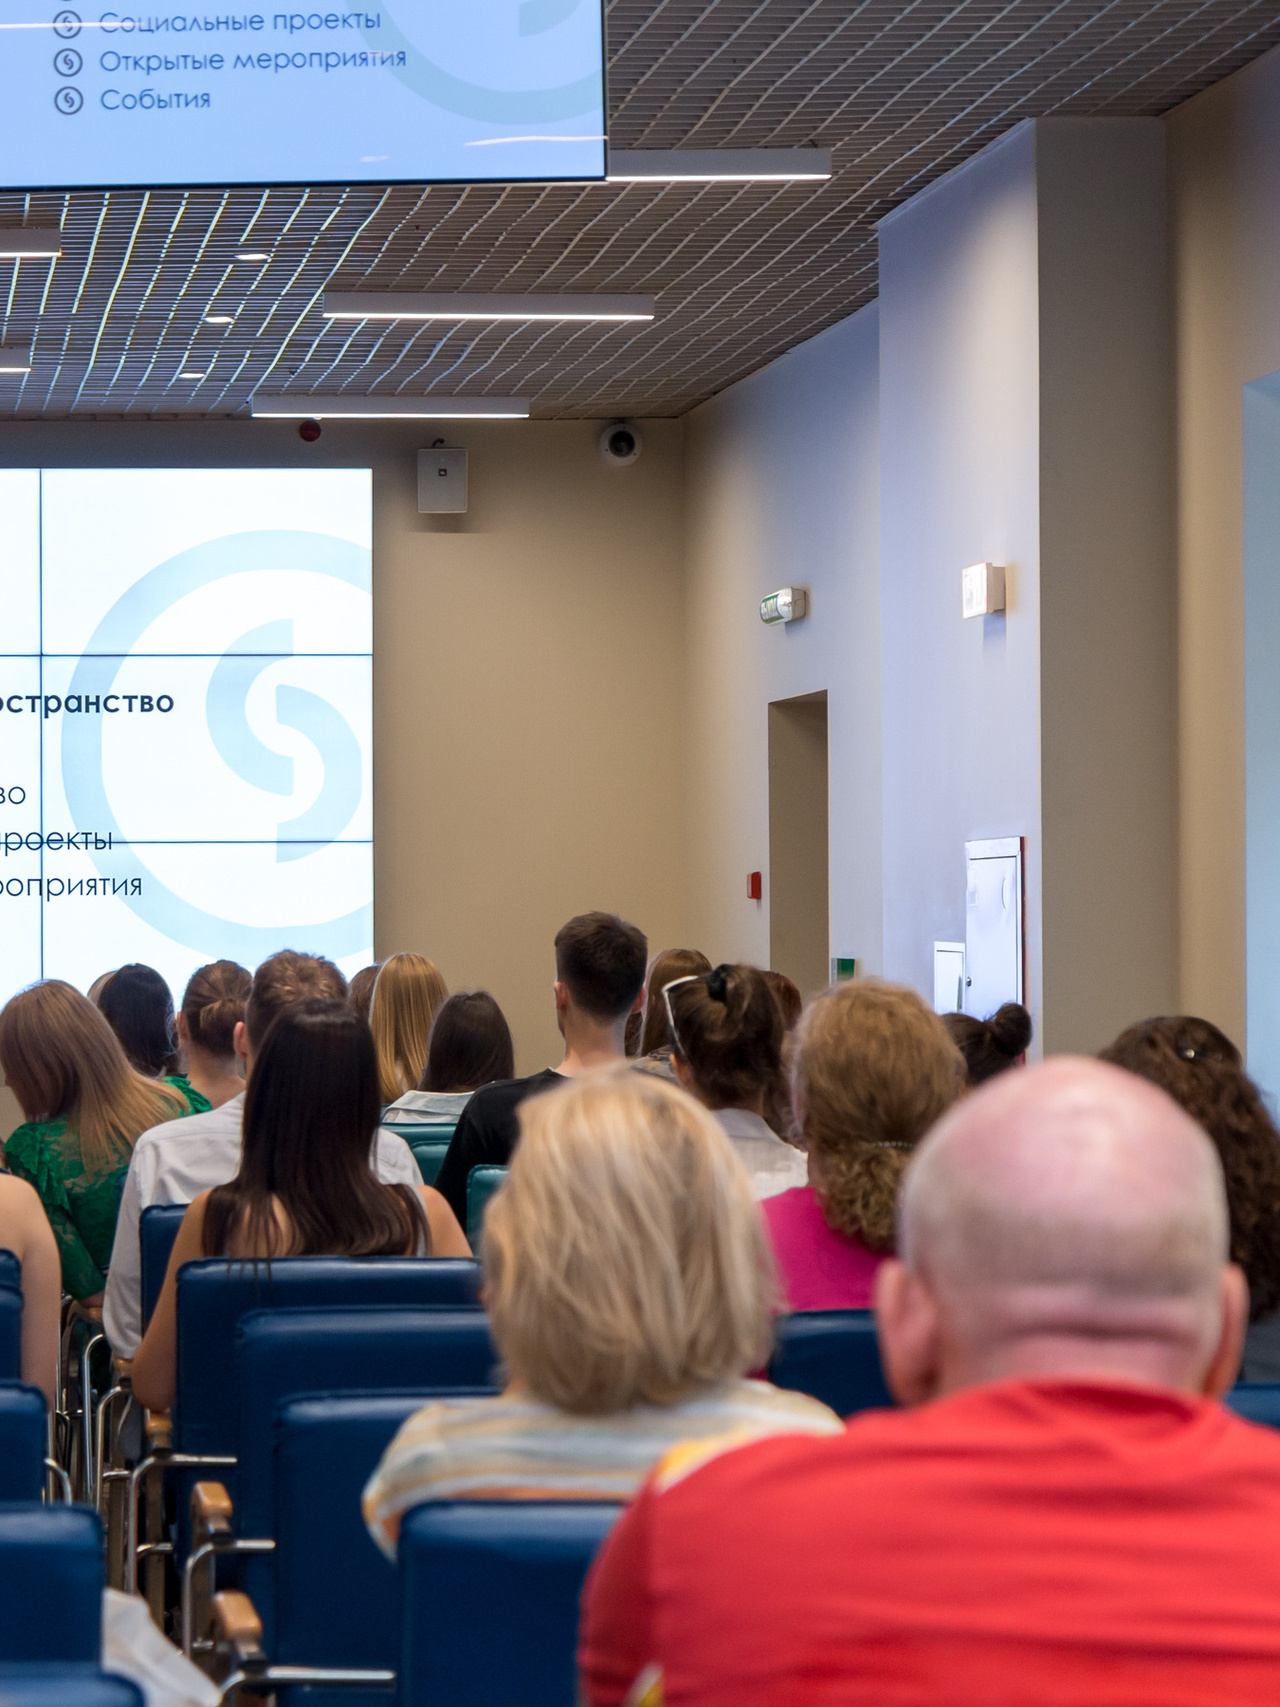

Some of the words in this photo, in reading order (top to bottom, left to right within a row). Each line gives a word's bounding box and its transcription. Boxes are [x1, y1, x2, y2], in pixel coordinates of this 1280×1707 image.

[99, 12, 265, 34] Социальные
[273, 13, 381, 34] проекты
[100, 50, 225, 75] Открытые
[233, 50, 407, 73] мероприятия
[100, 88, 211, 111] События
